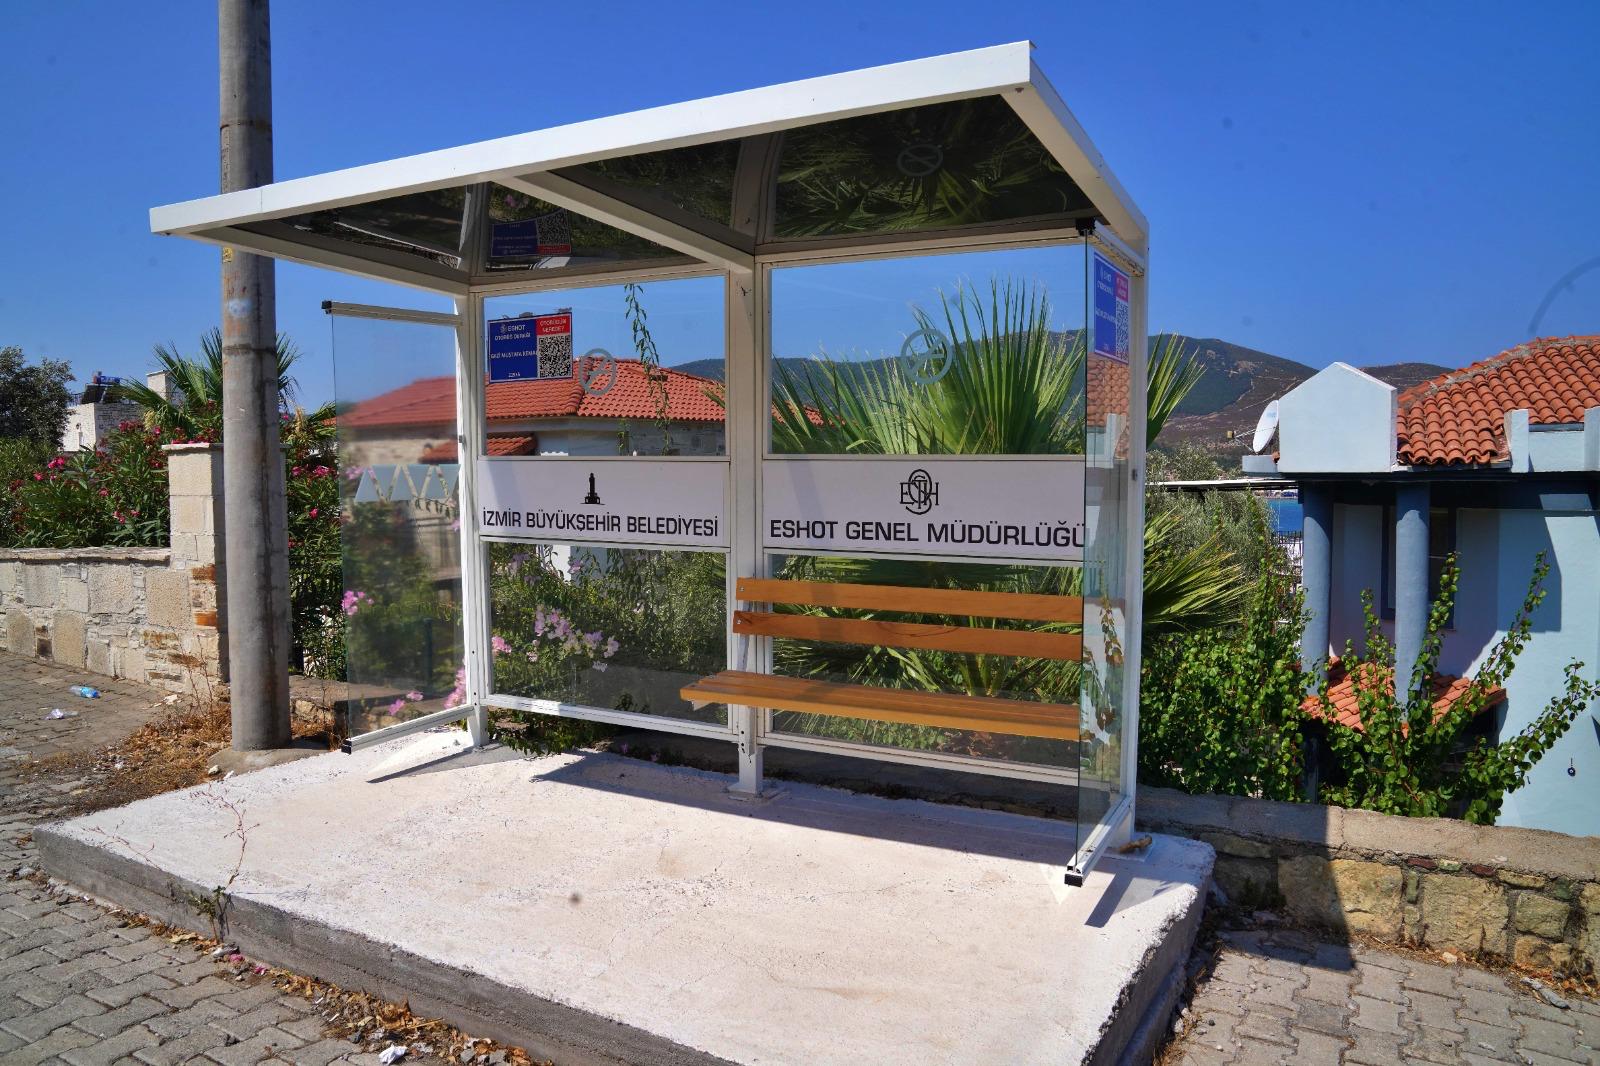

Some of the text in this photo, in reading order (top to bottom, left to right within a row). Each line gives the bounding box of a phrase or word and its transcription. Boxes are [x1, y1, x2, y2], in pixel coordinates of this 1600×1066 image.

[482, 507, 719, 537] İZMİR BÜYÜKŞEHİR BELEDİYESİ
[770, 519, 1085, 548] ESHOT GENEL MÜDÜRLÜĞÜ
